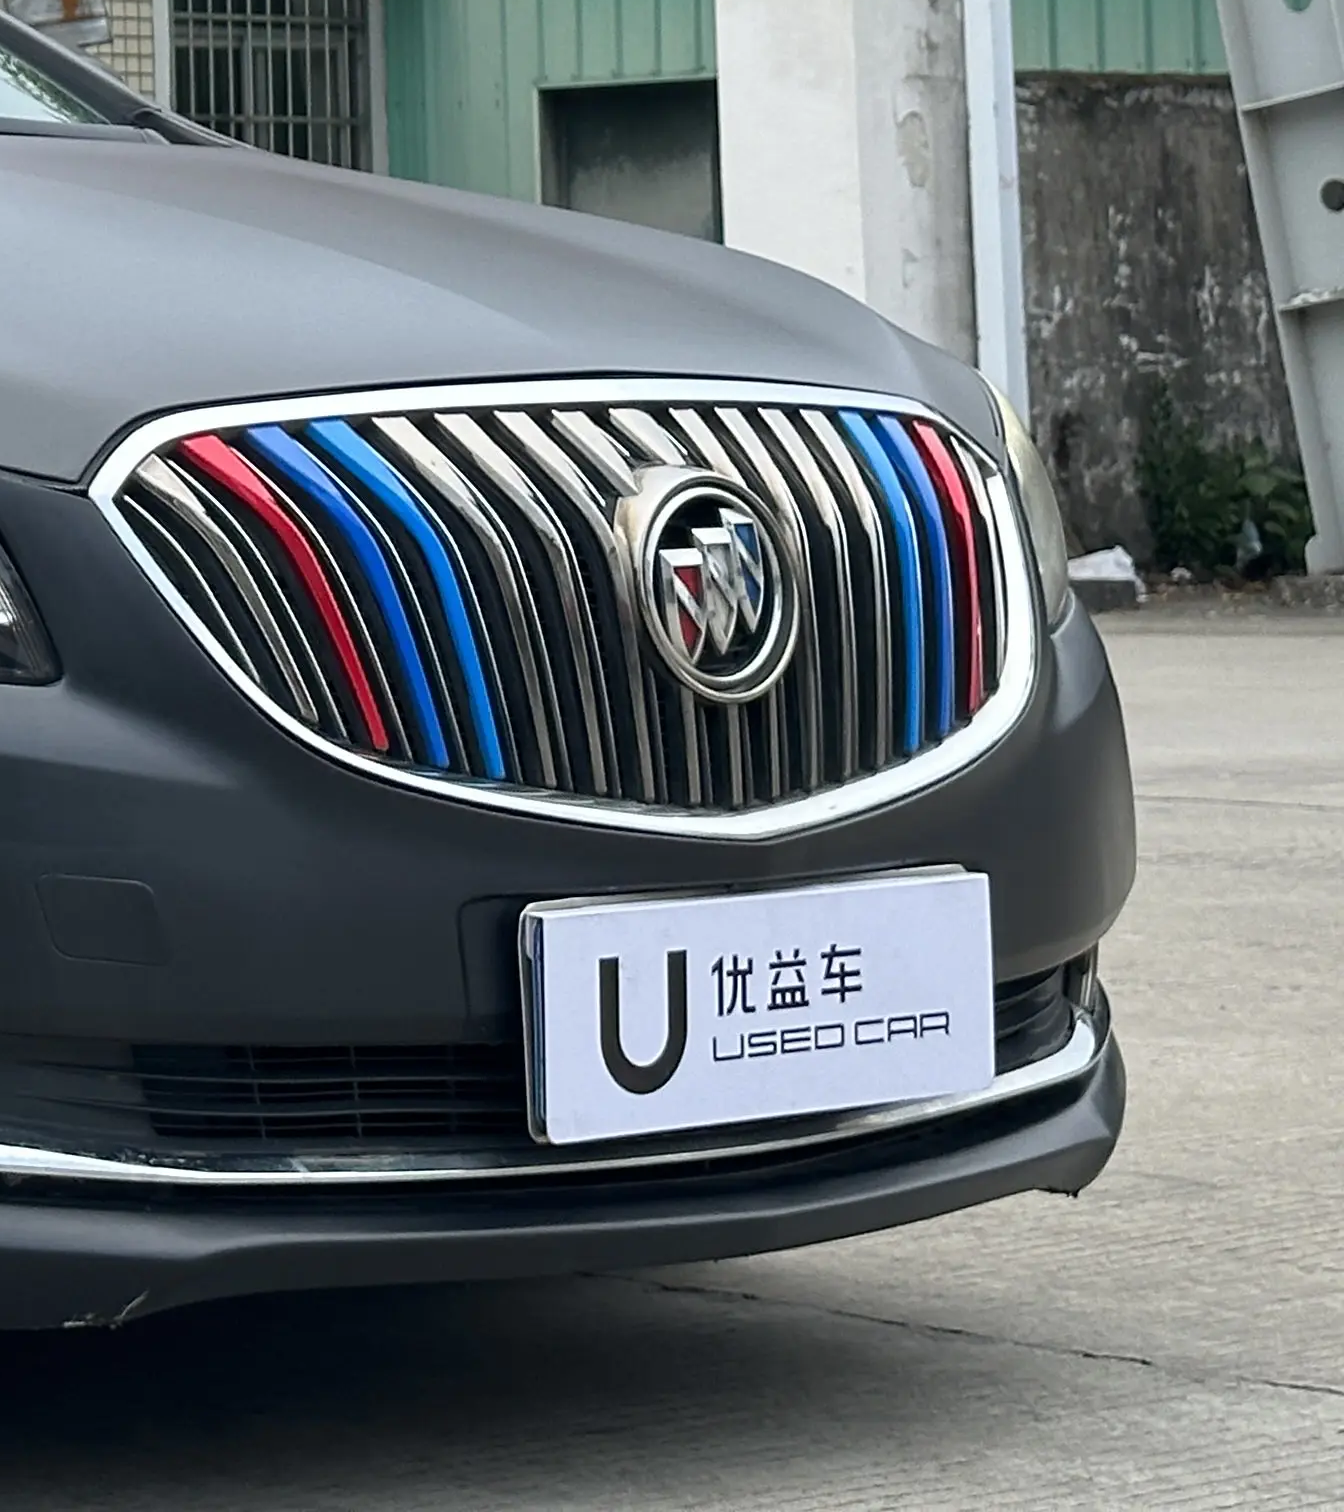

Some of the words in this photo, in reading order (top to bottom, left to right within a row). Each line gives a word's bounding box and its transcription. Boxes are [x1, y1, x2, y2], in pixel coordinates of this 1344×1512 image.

[711, 944, 863, 1016] 优益车
[598, 949, 687, 1095] U
[713, 1023, 845, 1062] USED
[854, 1011, 951, 1046] CAR
